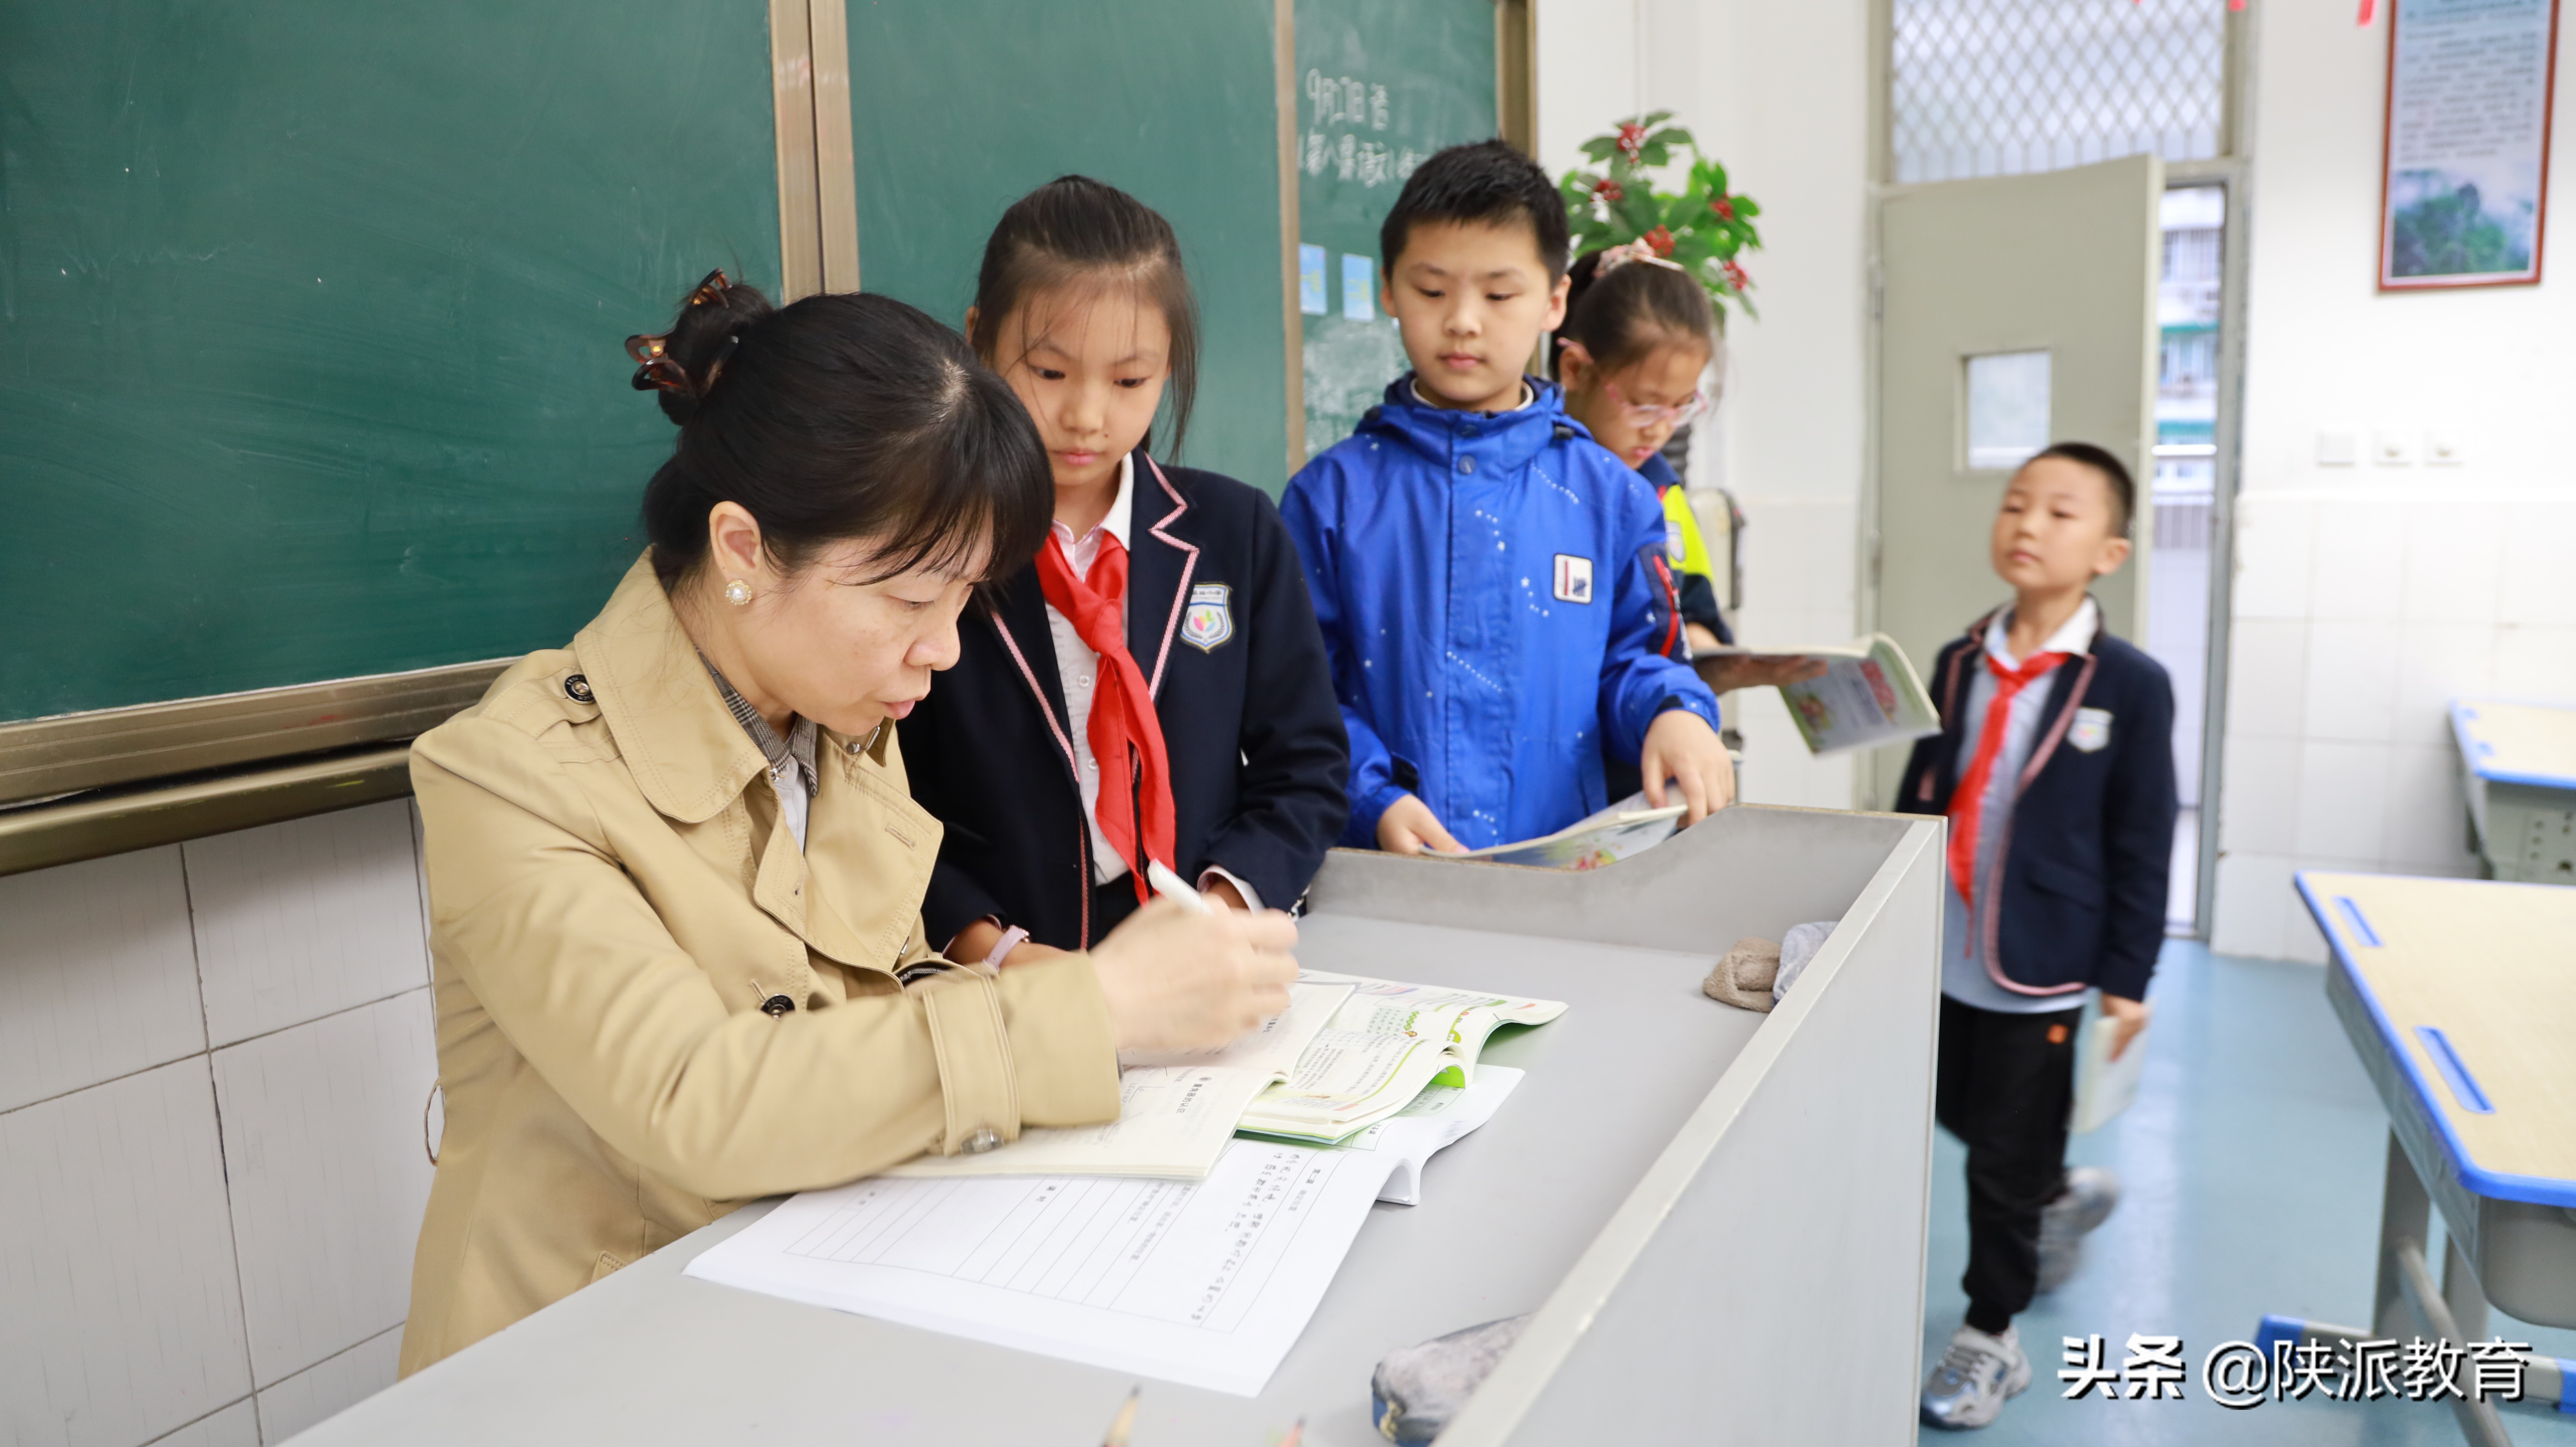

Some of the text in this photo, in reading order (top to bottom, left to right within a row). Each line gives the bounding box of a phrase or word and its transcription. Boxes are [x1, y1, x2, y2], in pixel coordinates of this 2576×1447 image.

[1176, 1084, 1203, 1113] 量角器的认识
